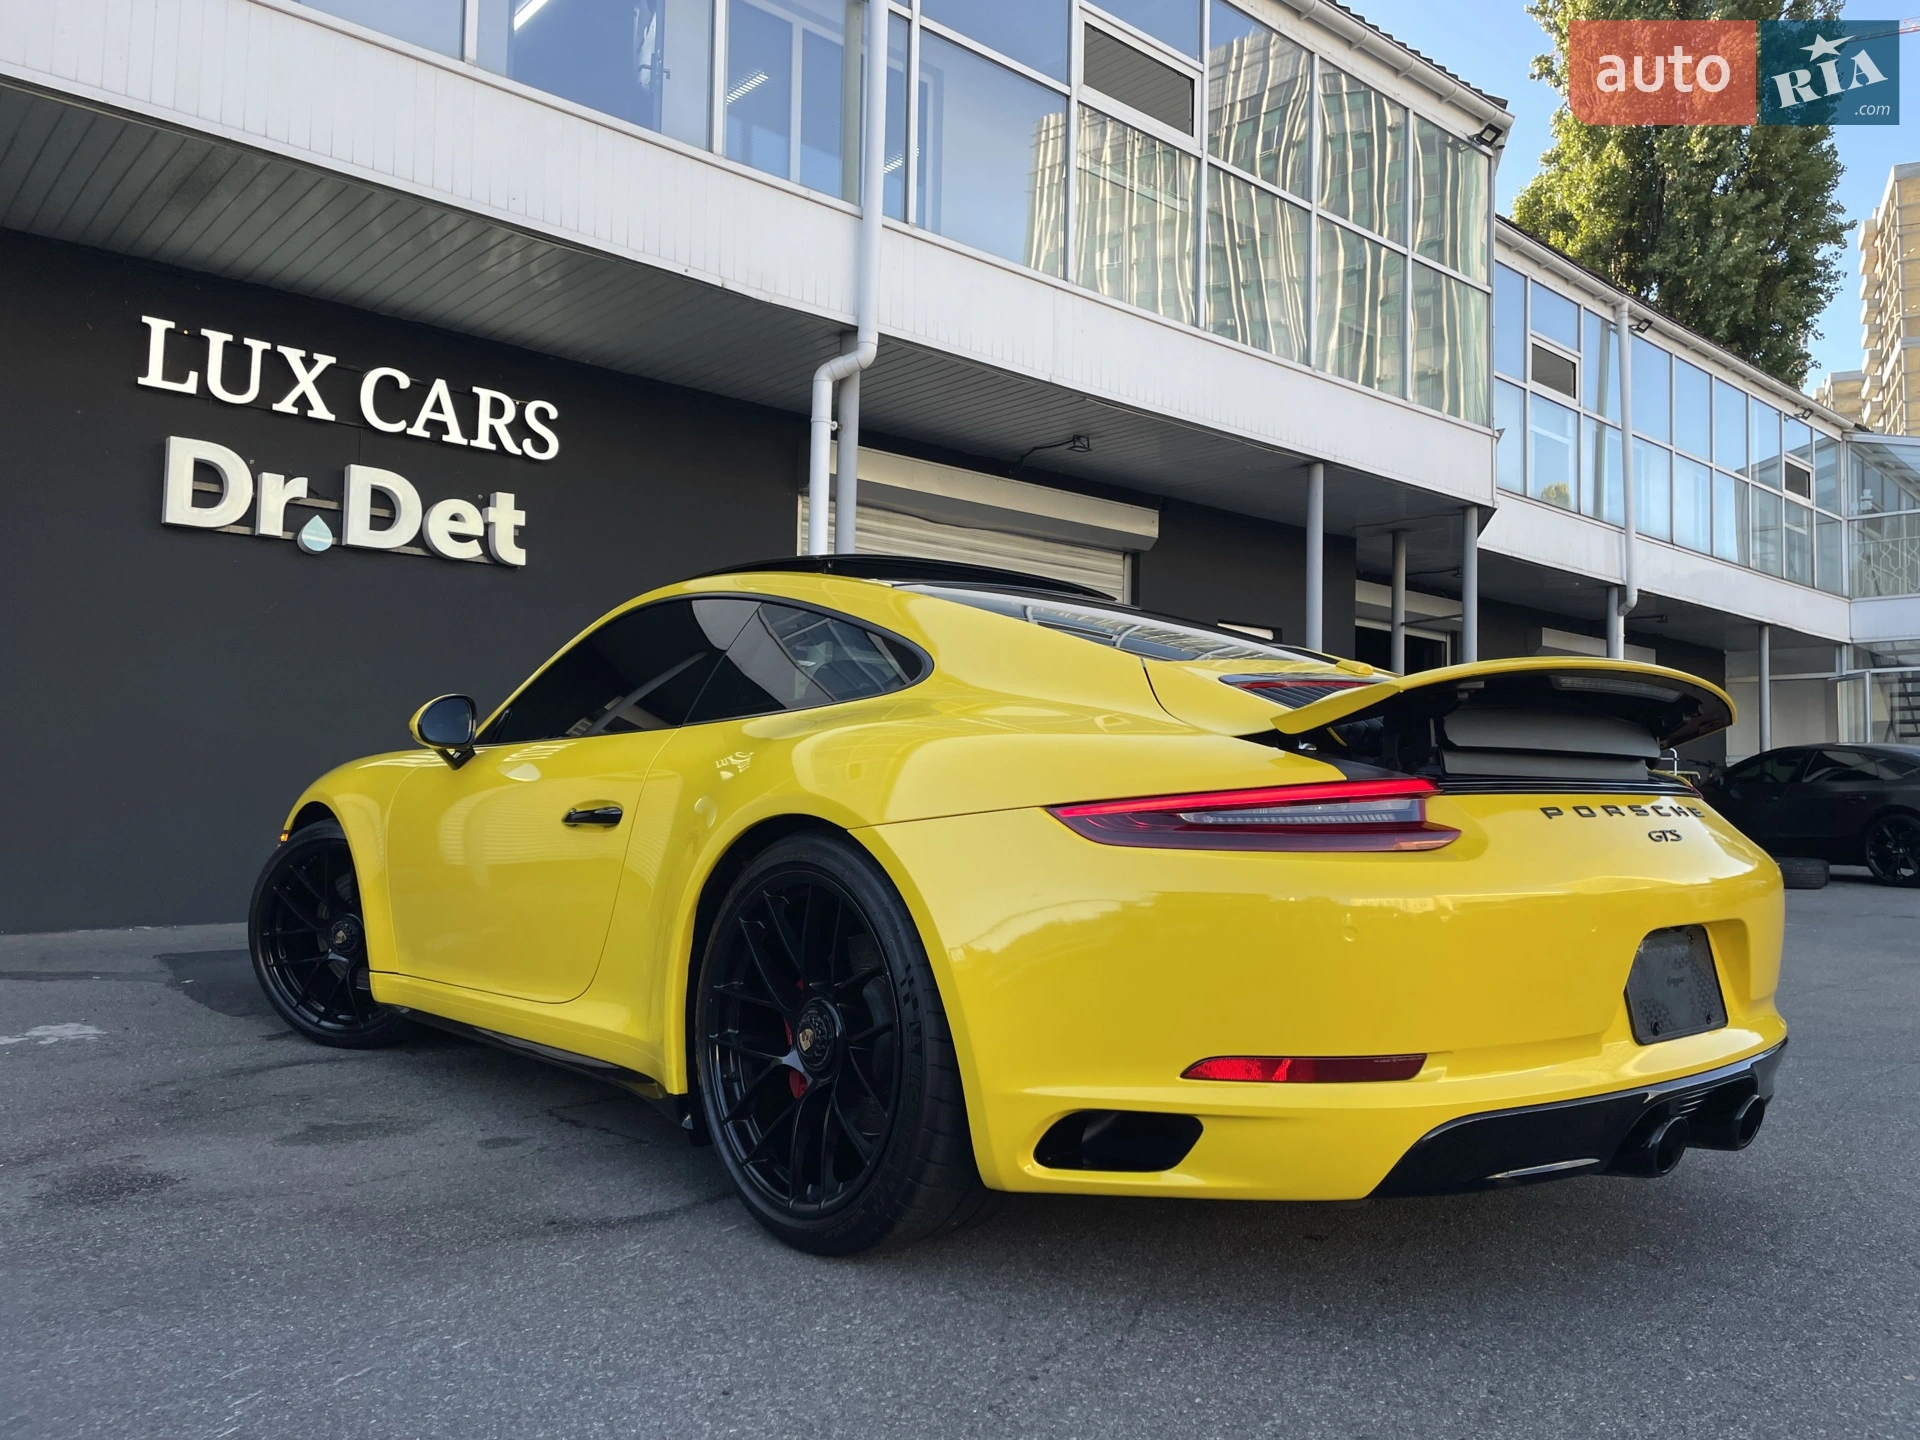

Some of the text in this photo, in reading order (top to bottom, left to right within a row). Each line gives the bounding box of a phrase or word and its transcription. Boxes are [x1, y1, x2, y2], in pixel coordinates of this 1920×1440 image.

[137, 315, 560, 461] LUX CARS
[1539, 804, 1705, 820] PORSCHE
[1648, 829, 1683, 842] GTS
